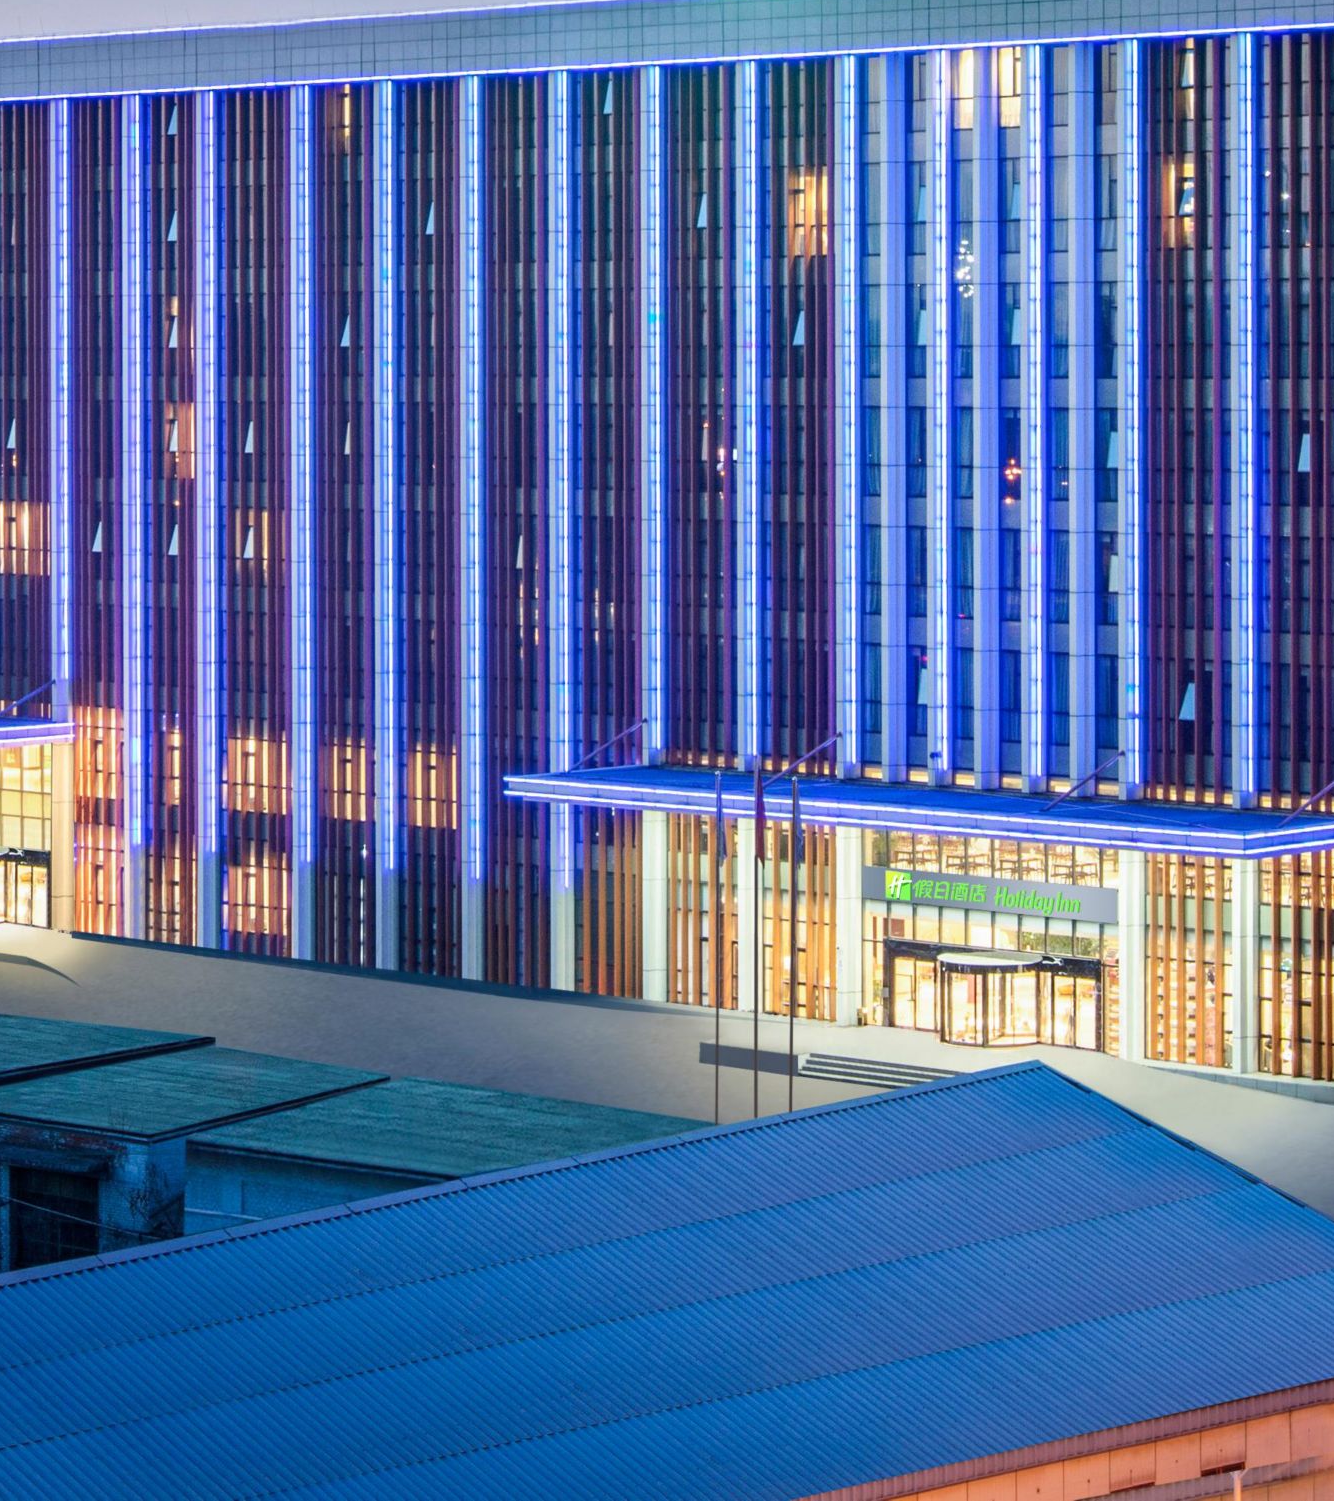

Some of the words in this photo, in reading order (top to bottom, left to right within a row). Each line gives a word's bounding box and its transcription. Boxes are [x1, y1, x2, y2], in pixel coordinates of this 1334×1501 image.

[913, 879, 987, 903] 假日酒店
[995, 886, 1055, 916] Holiday
[1055, 892, 1081, 913] Inn
